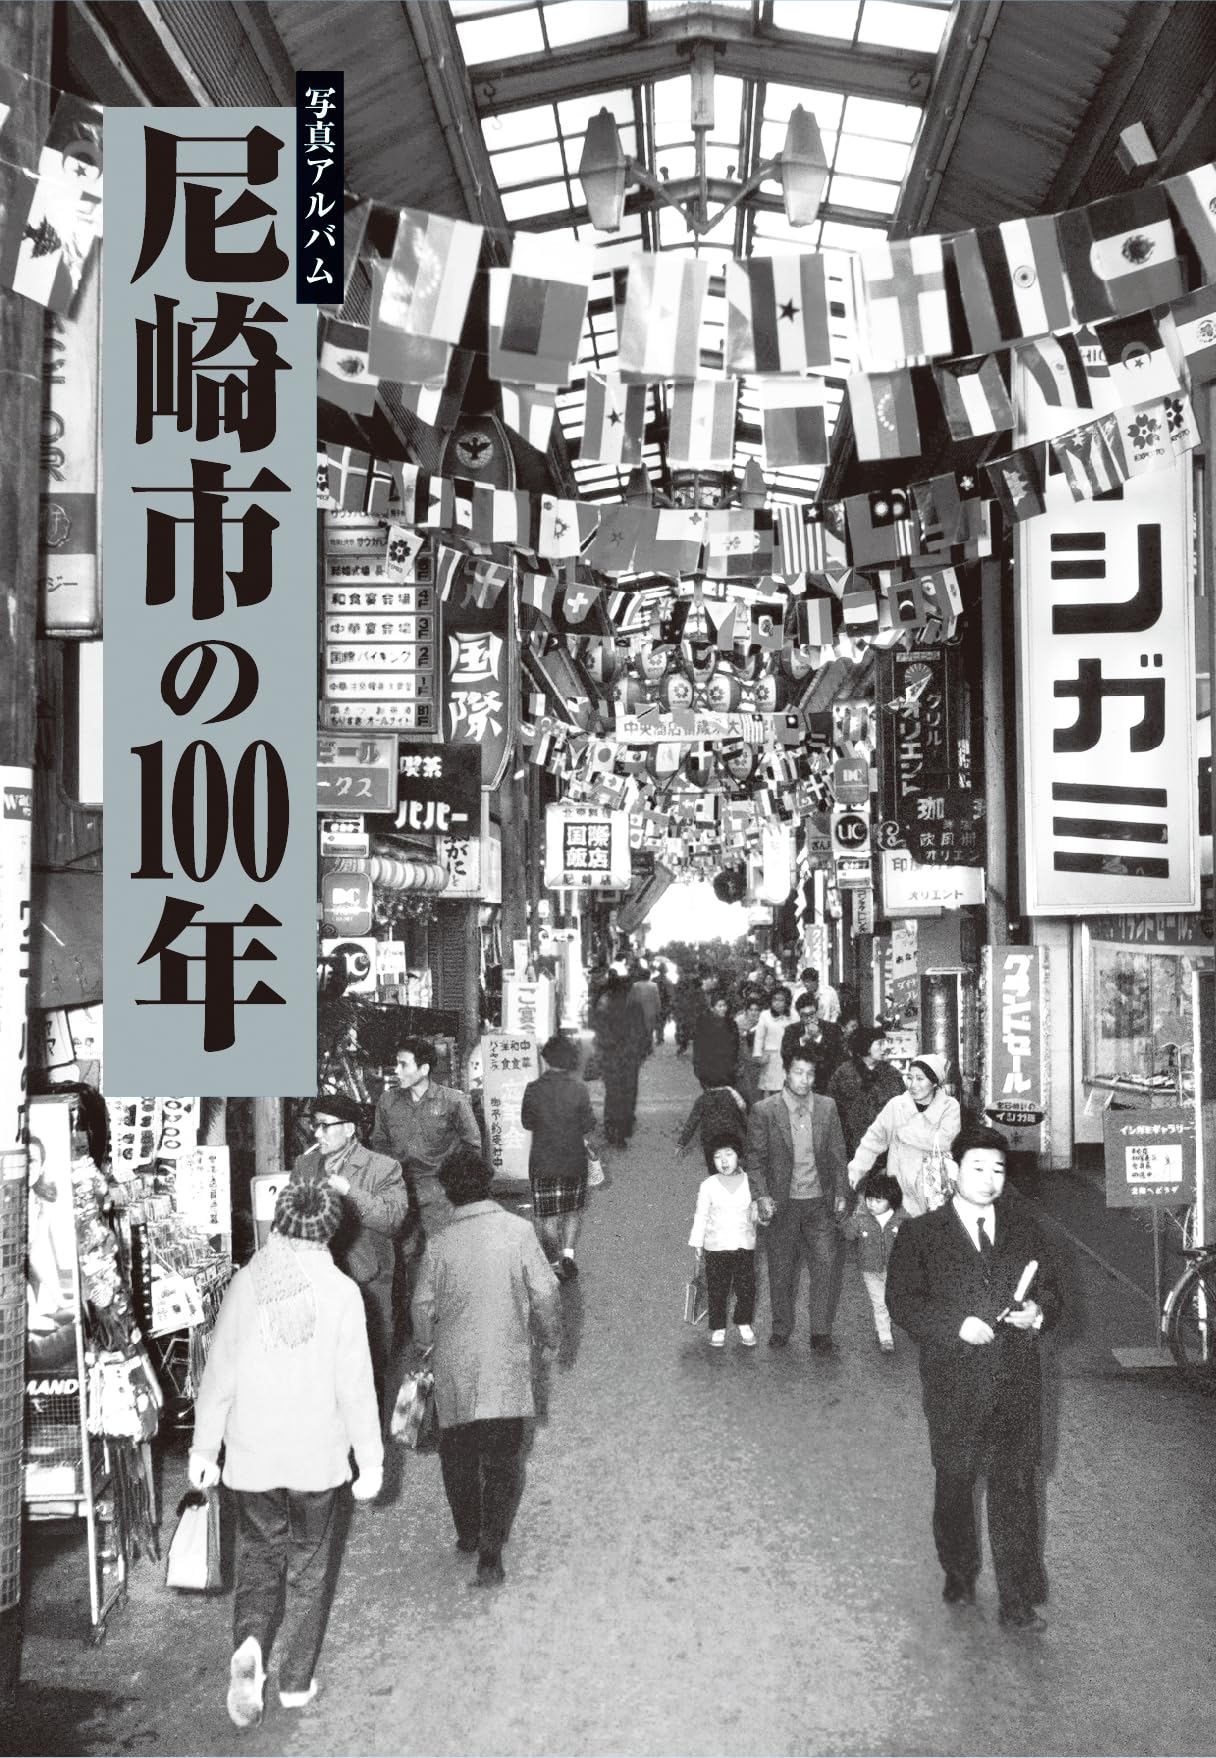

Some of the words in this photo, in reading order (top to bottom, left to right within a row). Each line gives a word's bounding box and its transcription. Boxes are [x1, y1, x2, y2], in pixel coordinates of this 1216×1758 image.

[448, 631, 505, 742] 国際
[1050, 484, 1169, 878] シガミ
[400, 756, 442, 778] 喫茶
[838, 823, 867, 840] UC
